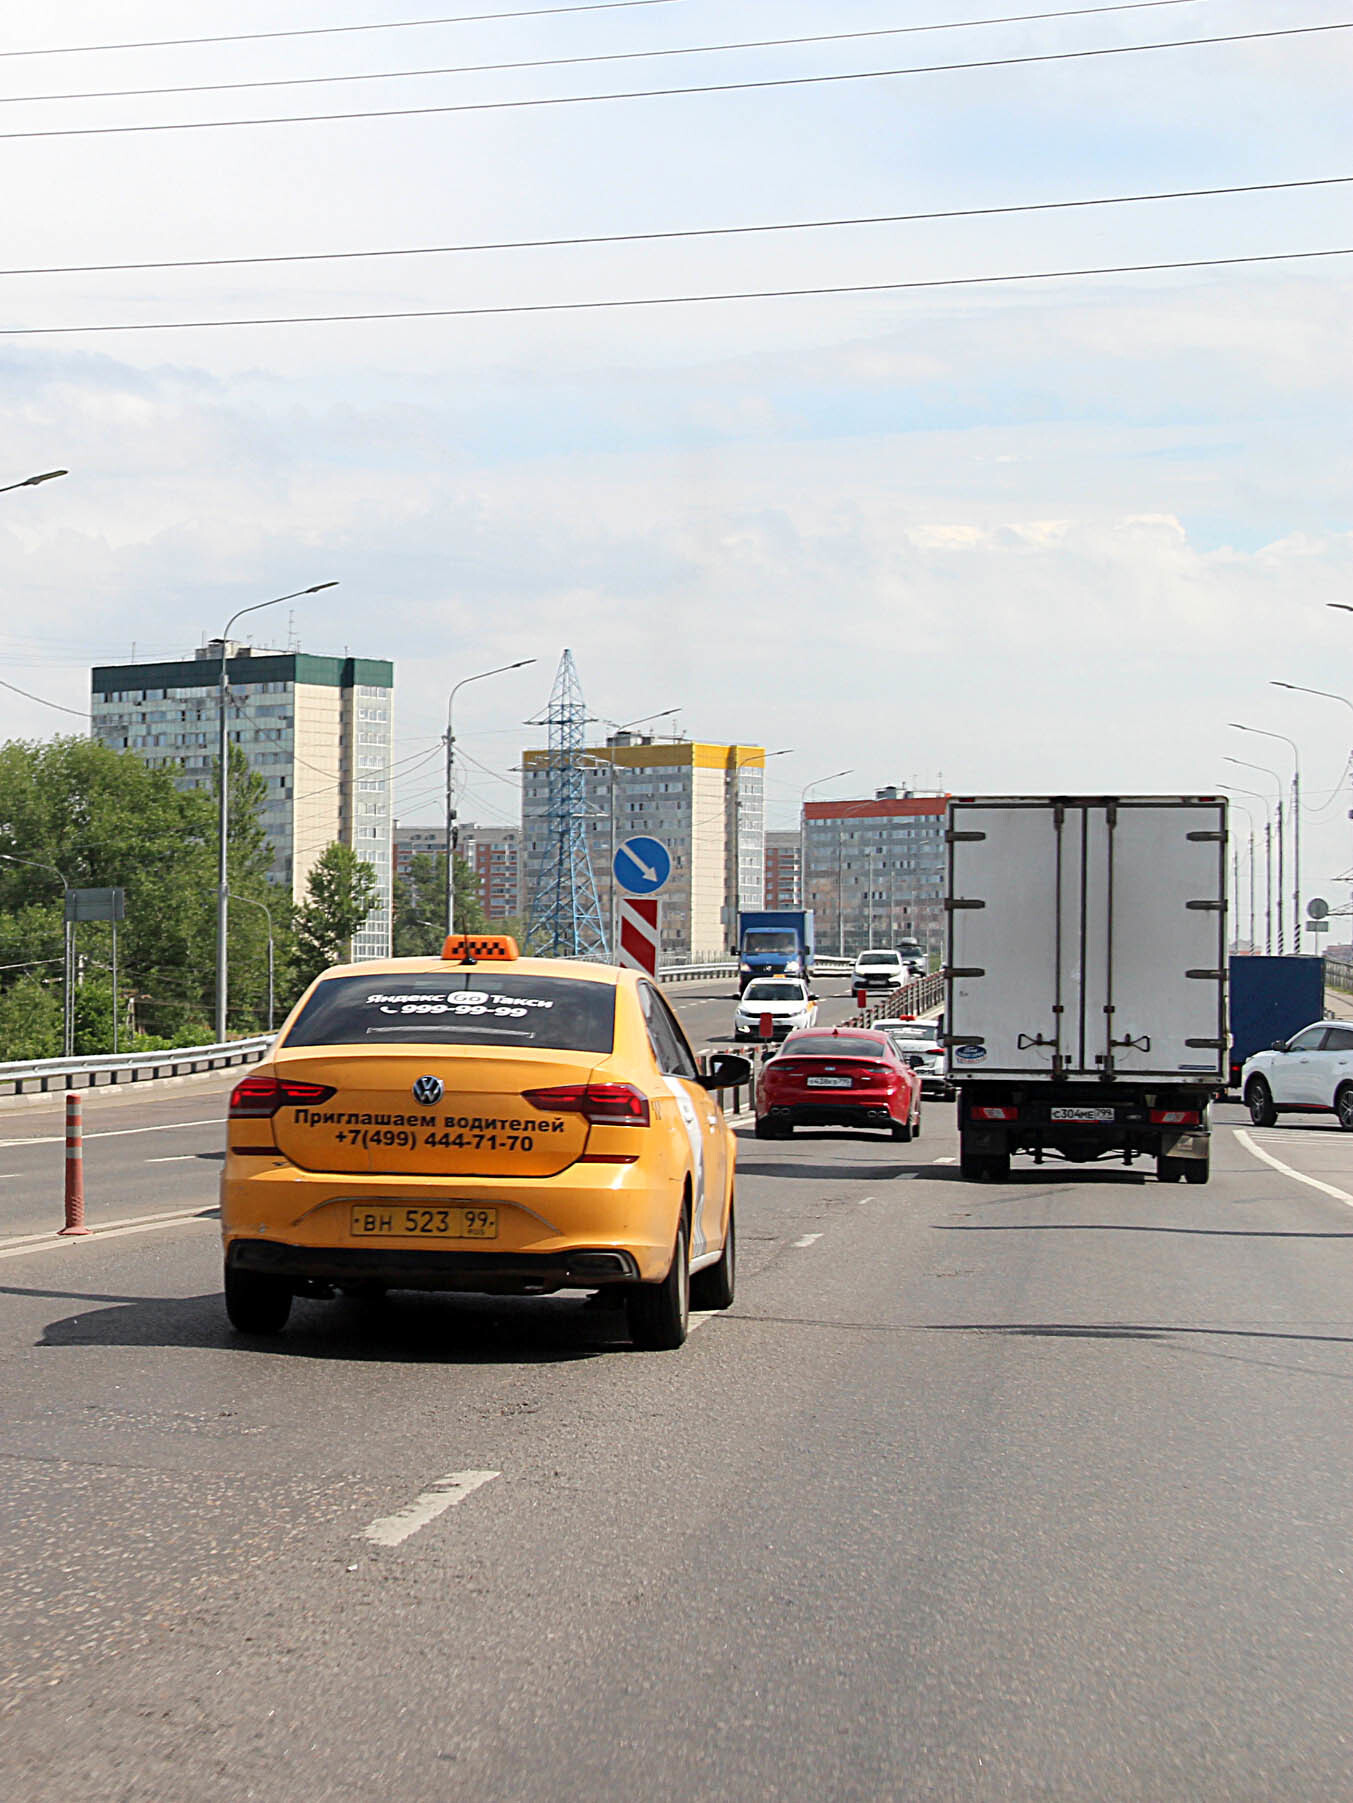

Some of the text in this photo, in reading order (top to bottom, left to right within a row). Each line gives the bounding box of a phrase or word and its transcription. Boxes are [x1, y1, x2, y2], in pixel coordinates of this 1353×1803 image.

[366, 994, 447, 1004] Яндекс
[490, 994, 555, 1008] Такси
[401, 1004, 529, 1018] 999-99-99
[294, 1109, 565, 1133] Приглашаем водителей
[336, 1130, 534, 1152] +7(499) 444-71-70
[405, 1210, 450, 1233] 523
[464, 1211, 489, 1228] 99
